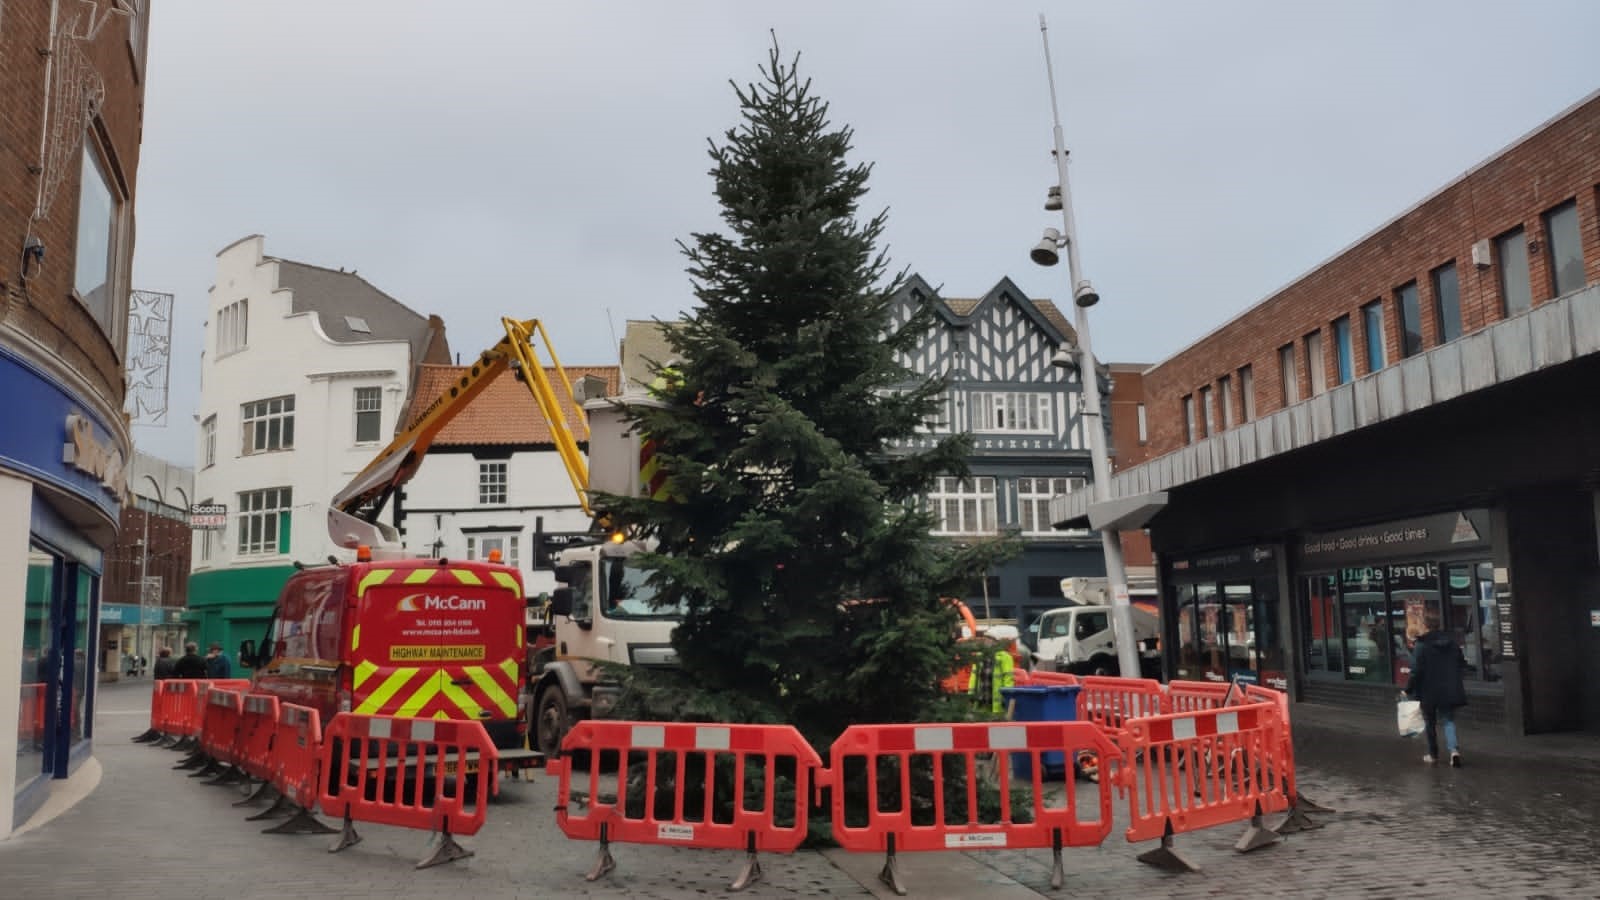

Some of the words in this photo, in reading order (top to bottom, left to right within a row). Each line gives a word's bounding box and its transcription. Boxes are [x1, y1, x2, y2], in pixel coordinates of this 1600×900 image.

[191, 504, 225, 513] Scotts
[1304, 543, 1320, 553] Good
[1340, 537, 1357, 550] Good
[1358, 535, 1378, 547] drinks
[1384, 530, 1403, 543] Good
[1404, 527, 1426, 540] times
[424, 595, 486, 610] McCann
[392, 647, 427, 658] HIGHWAY
[430, 647, 484, 658] MAINTENANCE
